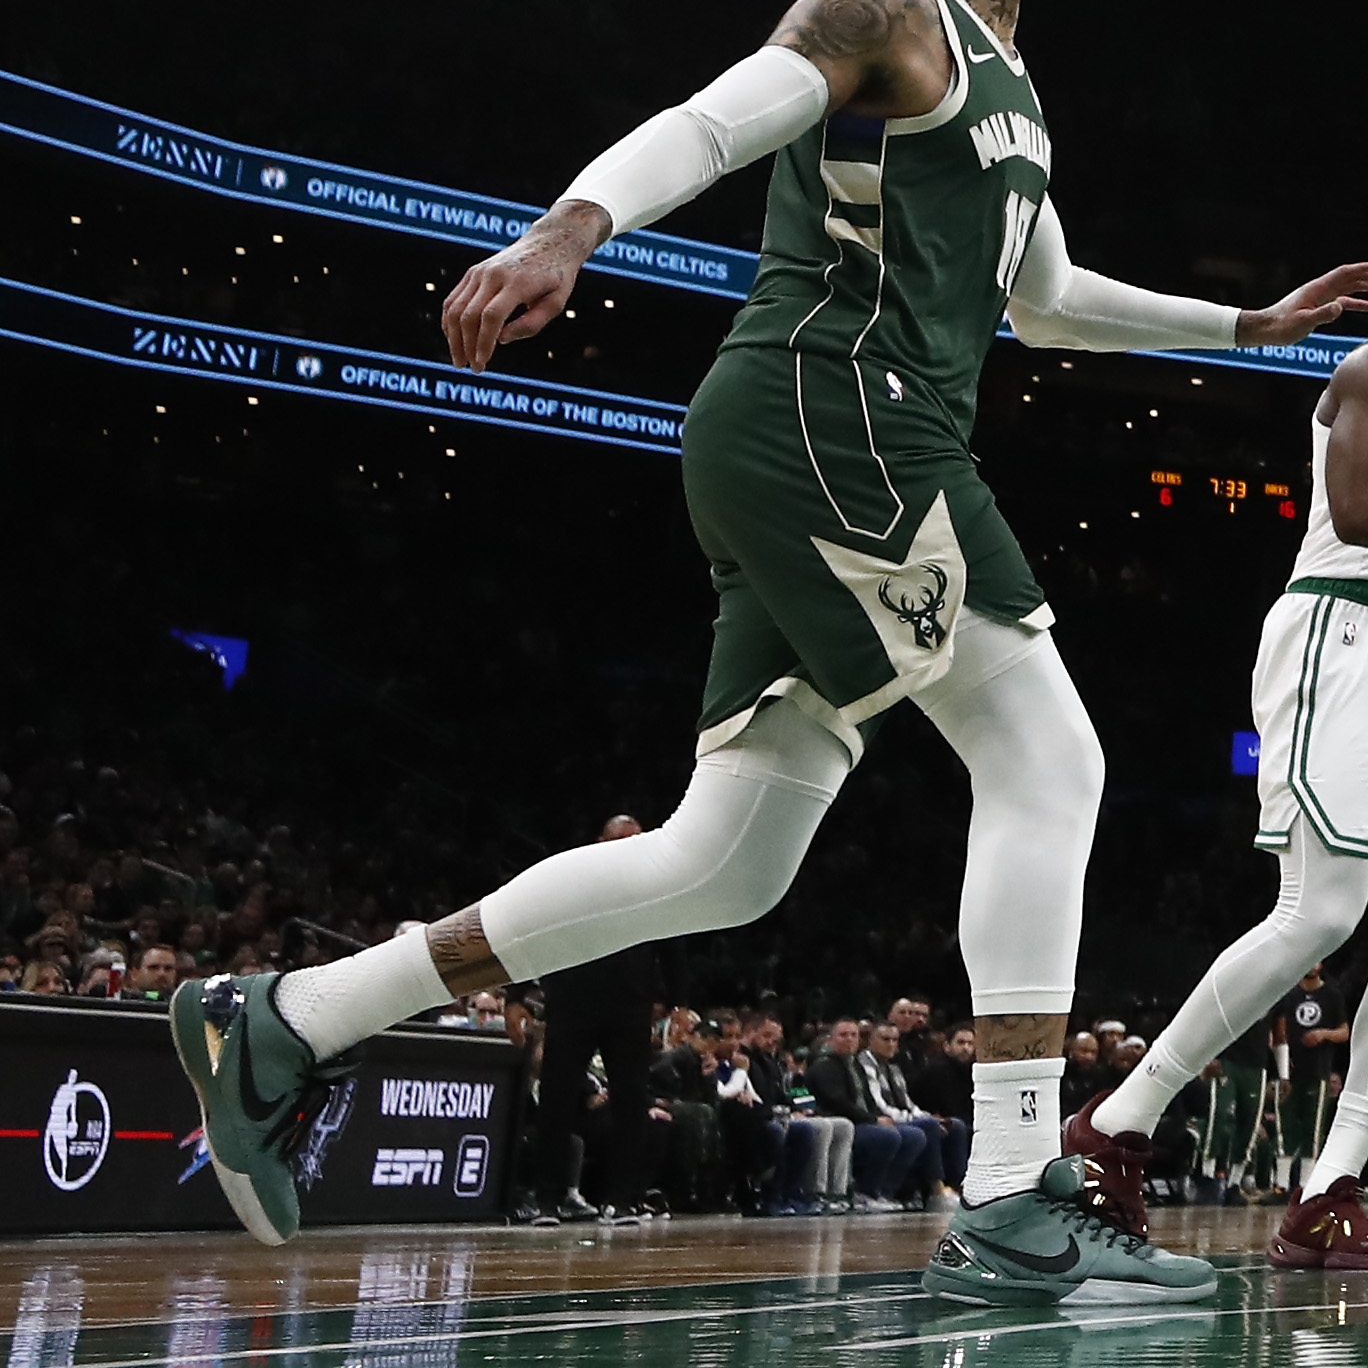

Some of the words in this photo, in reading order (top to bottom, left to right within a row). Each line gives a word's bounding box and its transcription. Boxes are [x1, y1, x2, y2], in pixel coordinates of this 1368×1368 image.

[306, 177, 401, 217] OFFICIAL
[404, 197, 503, 235] EYEWEAR
[656, 251, 728, 281] CELTICS
[340, 364, 431, 398] OFFICIAL
[434, 380, 530, 415] EYEWEAR
[532, 395, 558, 417] OF
[562, 402, 599, 425] THE
[601, 410, 676, 439] BOSTON
[1159, 486, 1173, 507] 6
[1278, 499, 1296, 519] 16
[1209, 477, 1247, 499] 7:33
[380, 1078, 495, 1120] WEDNESDAY
[372, 1147, 445, 1186] ESPN
